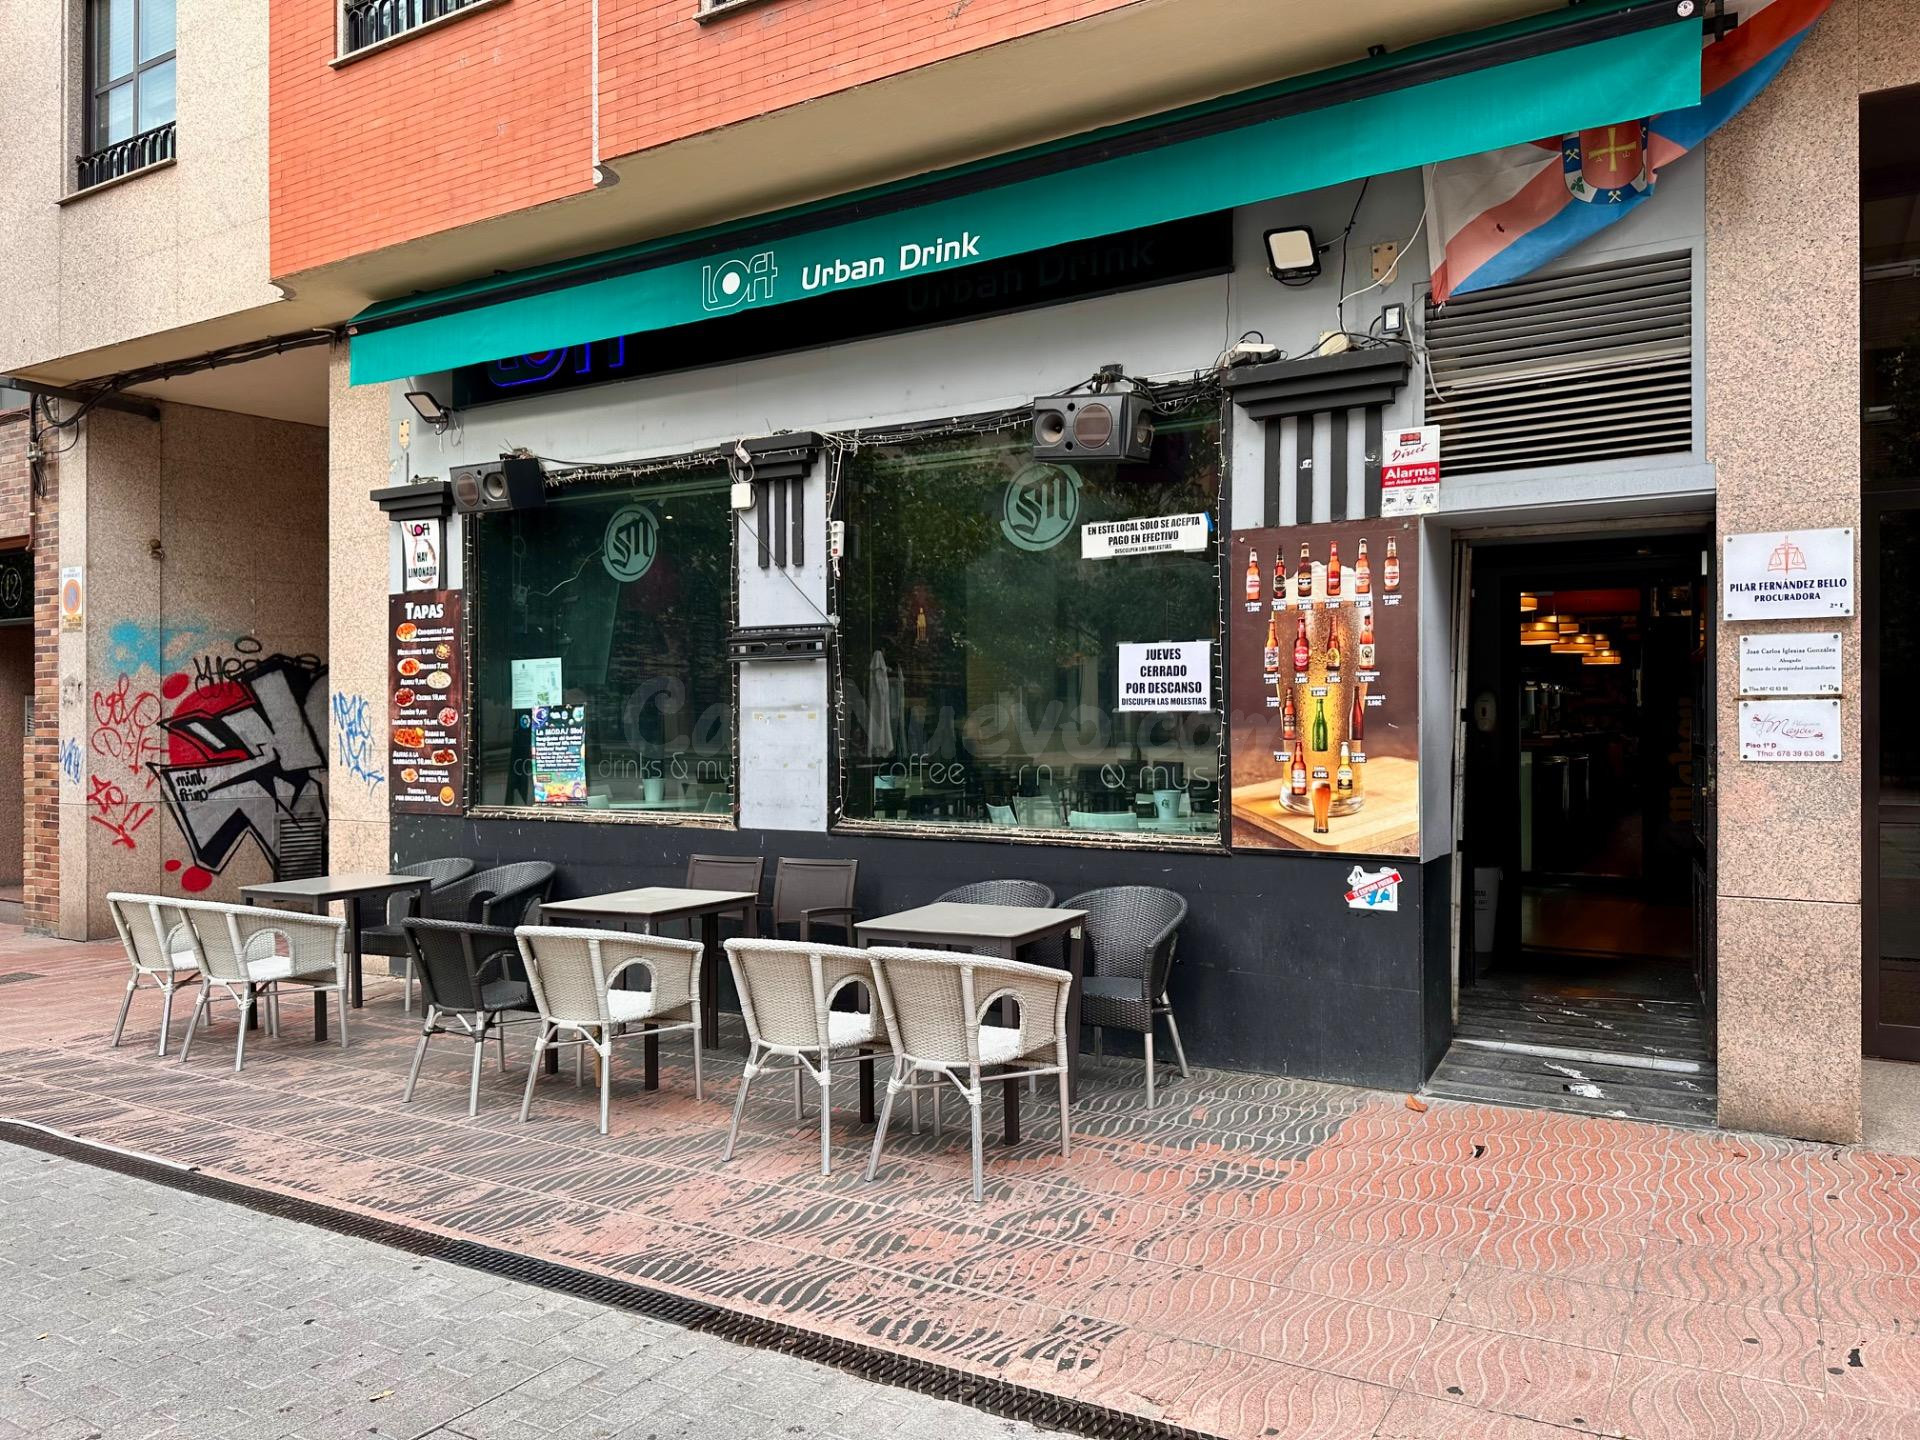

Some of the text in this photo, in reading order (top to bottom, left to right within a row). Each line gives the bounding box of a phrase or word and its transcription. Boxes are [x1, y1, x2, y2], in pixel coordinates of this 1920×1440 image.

[802, 255, 884, 290] Urban
[900, 231, 980, 271] Drink
[1385, 467, 1436, 480] Alarma
[1088, 516, 1200, 535] EN ESTE LOCAL SOLO SE ACEPTA
[1108, 530, 1179, 546] PAGO EN EFECTIVO
[1730, 578, 1847, 592] PILAR FERNÁNDEZ BELLO
[1754, 592, 1821, 602] PROCURADORA
[1145, 648, 1181, 660] JUEVES
[1140, 665, 1187, 677] CERRADO
[1126, 682, 1202, 694] POR DESCANSO
[1122, 697, 1207, 705] DISCULPEN LAS MOLESTIAS
[599, 752, 662, 780] drinks
[670, 752, 690, 780] &
[877, 753, 965, 786] coffee
[1100, 764, 1211, 791] & mus
